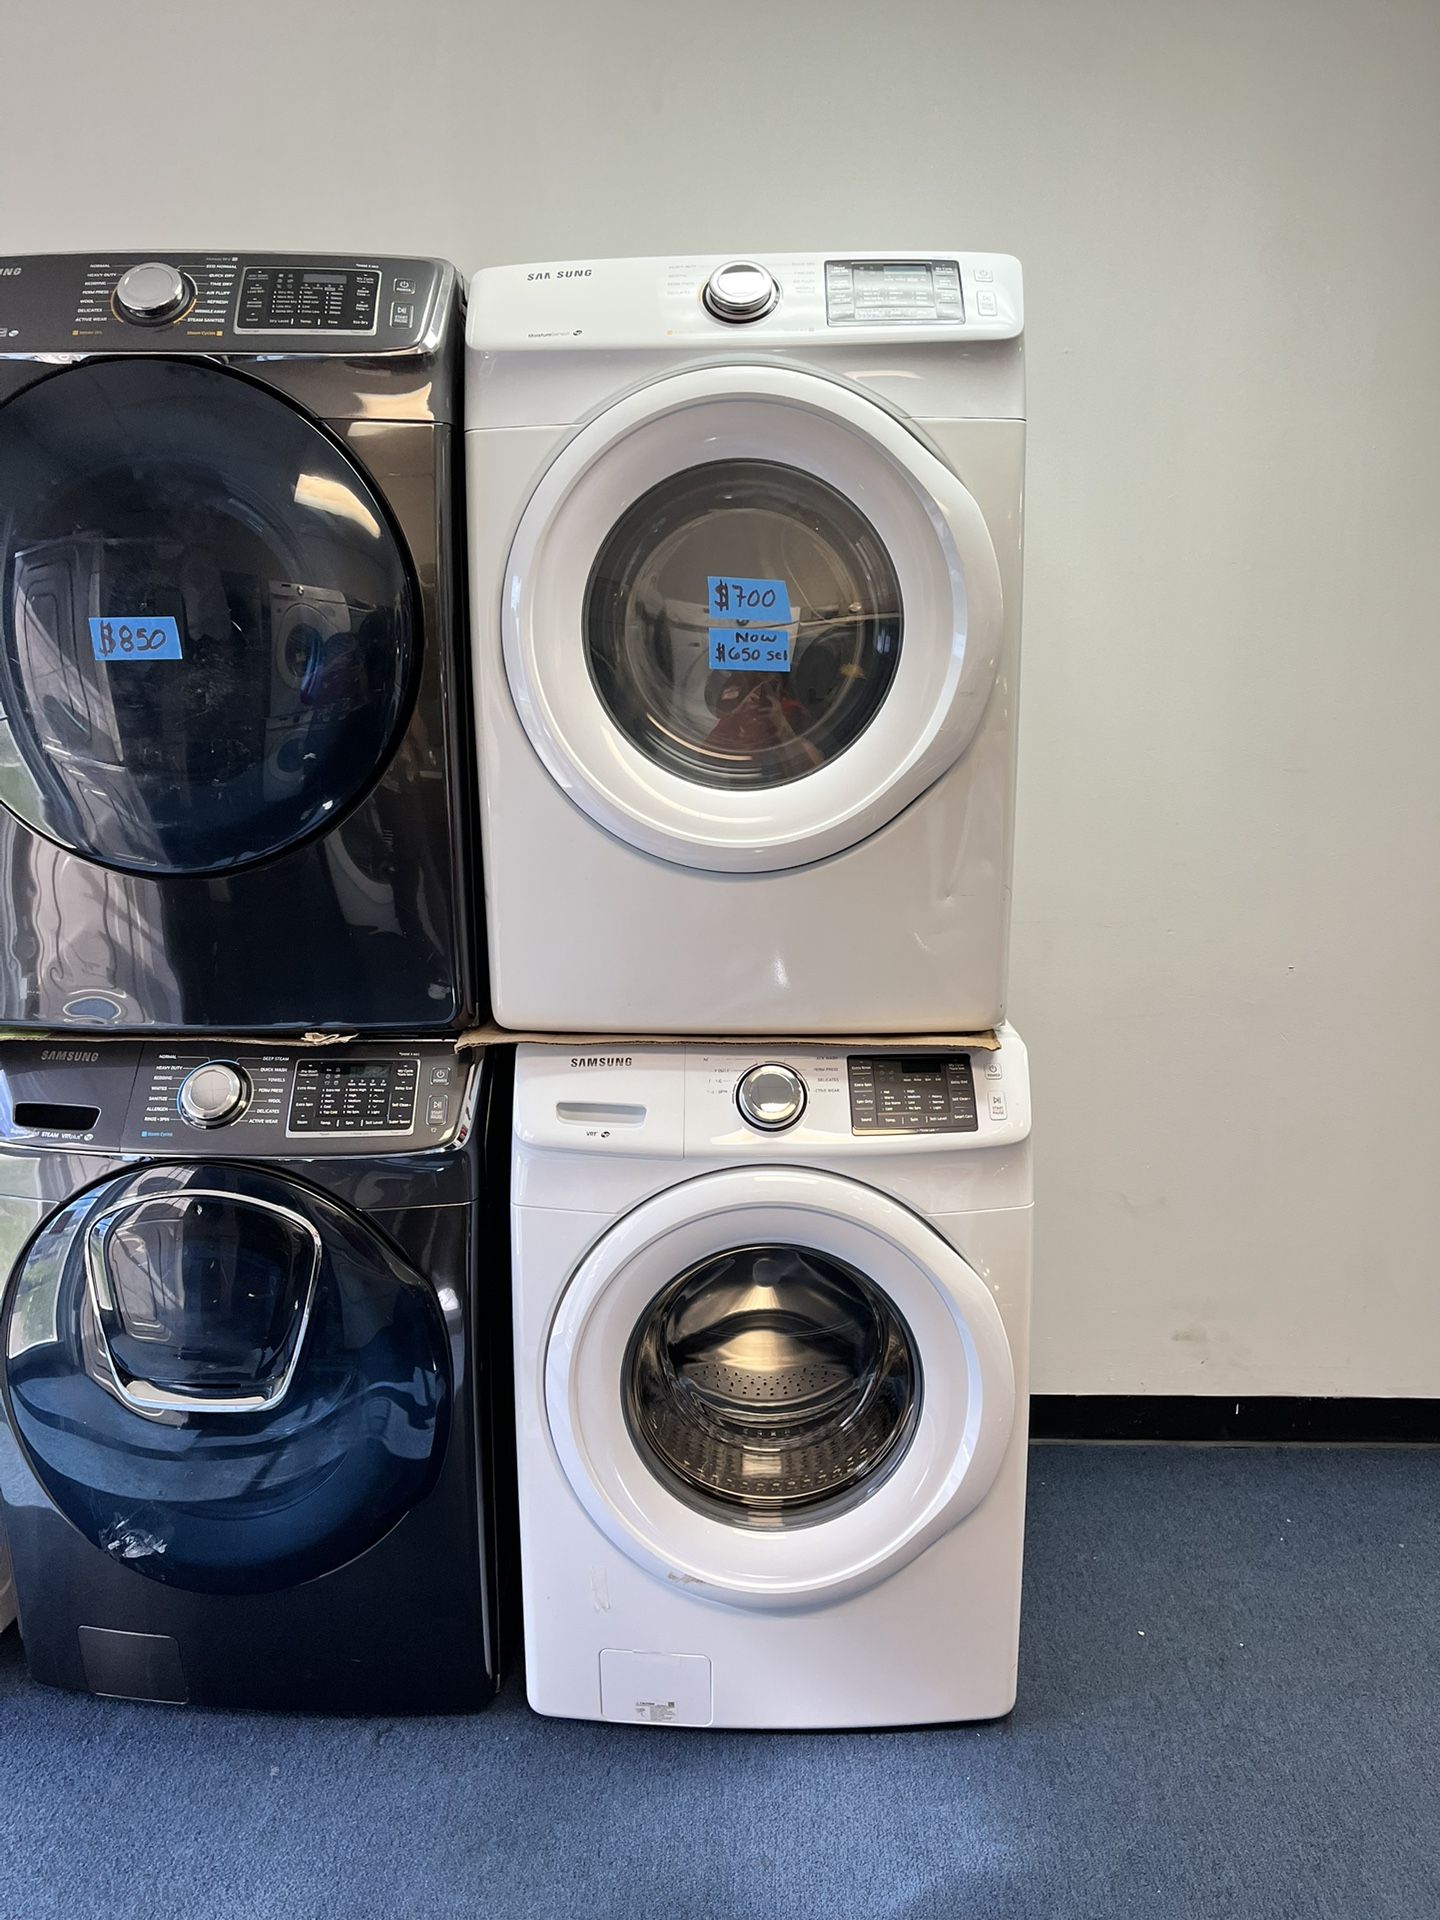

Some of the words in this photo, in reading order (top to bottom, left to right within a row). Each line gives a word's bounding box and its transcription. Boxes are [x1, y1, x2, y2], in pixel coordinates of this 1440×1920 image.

[714, 579, 776, 612] $700
[100, 620, 166, 656] $850
[715, 642, 760, 662] $650
[40, 1050, 99, 1062] SAMSUNG
[570, 1057, 632, 1068] SAMSUNG
